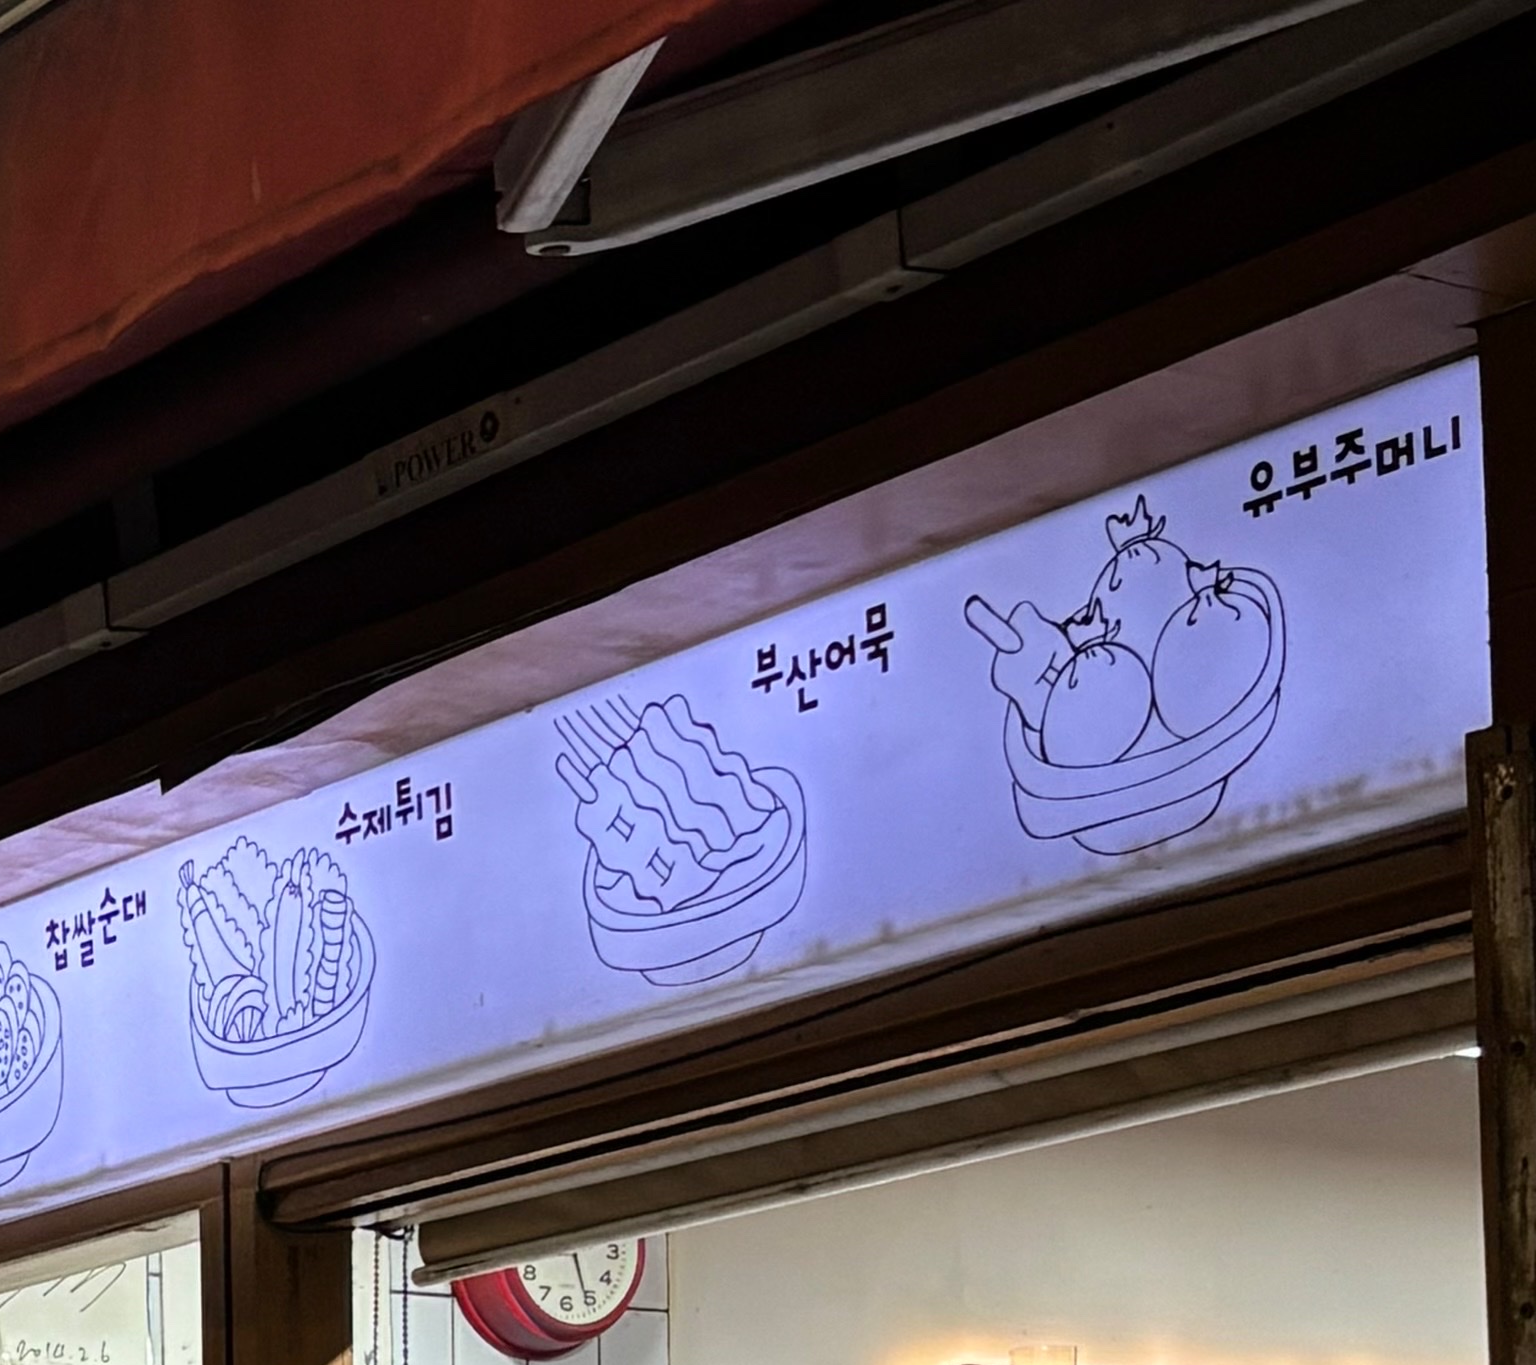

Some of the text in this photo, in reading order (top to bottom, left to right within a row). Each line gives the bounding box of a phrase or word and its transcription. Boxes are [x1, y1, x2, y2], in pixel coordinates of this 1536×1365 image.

[1243, 415, 1460, 517] 유부주머니
[751, 602, 894, 712] 부산어묵
[335, 777, 452, 843] 수제튀김
[46, 887, 146, 971] 찹쌀순대
[606, 1244, 619, 1260] 3
[523, 1265, 536, 1280] 8
[599, 1270, 612, 1285] 4
[539, 1286, 552, 1301] 7
[560, 1296, 573, 1311] 6
